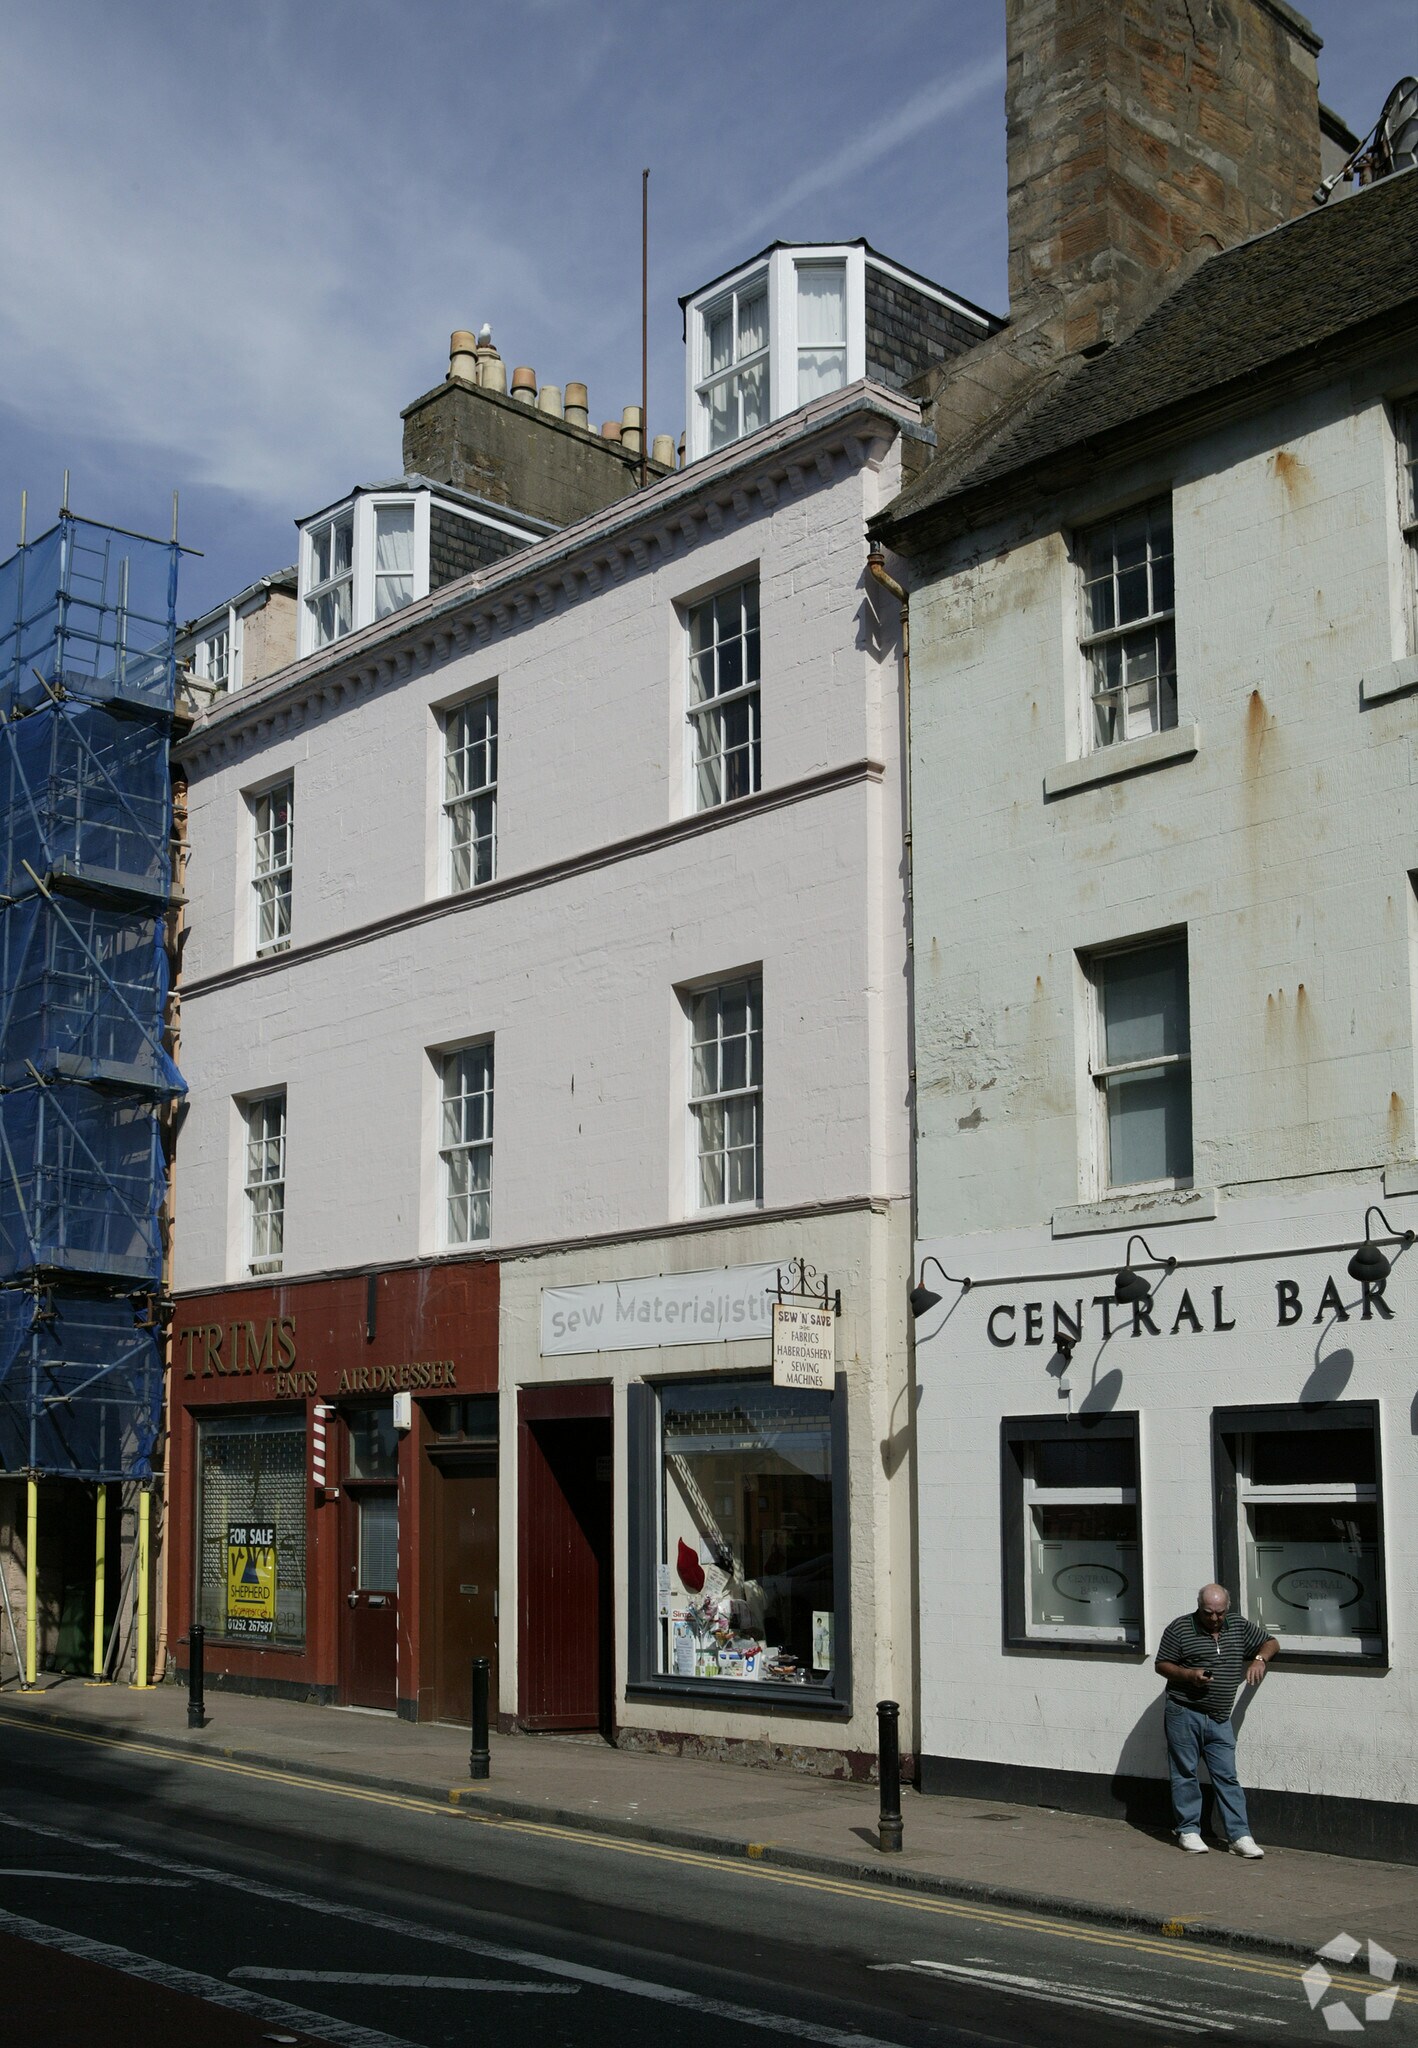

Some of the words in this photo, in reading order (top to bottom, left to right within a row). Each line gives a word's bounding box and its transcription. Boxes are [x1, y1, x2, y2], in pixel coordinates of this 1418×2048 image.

[778, 1310, 798, 1323] SEW
[810, 1314, 832, 1327] SAVE
[987, 1286, 1236, 1347] CENTRAL
[1275, 1275, 1396, 1327] BAR
[552, 1302, 604, 1338] Sew
[791, 1331, 819, 1344] FABRICS
[180, 1316, 296, 1378] TRIMS
[777, 1345, 832, 1360] HABERDASHERY
[791, 1361, 820, 1374] SEWING
[276, 1371, 318, 1398] ENTS
[338, 1360, 457, 1394] AIRDRESSER
[786, 1373, 823, 1387] MACHINES
[230, 1529, 247, 1544] FOR
[250, 1529, 274, 1545] SALE
[1291, 1579, 1343, 1590] CENTRAL
[231, 1585, 271, 1600] SHEPHERD
[228, 1619, 247, 1631] 01292
[248, 1620, 273, 1633] 267987
